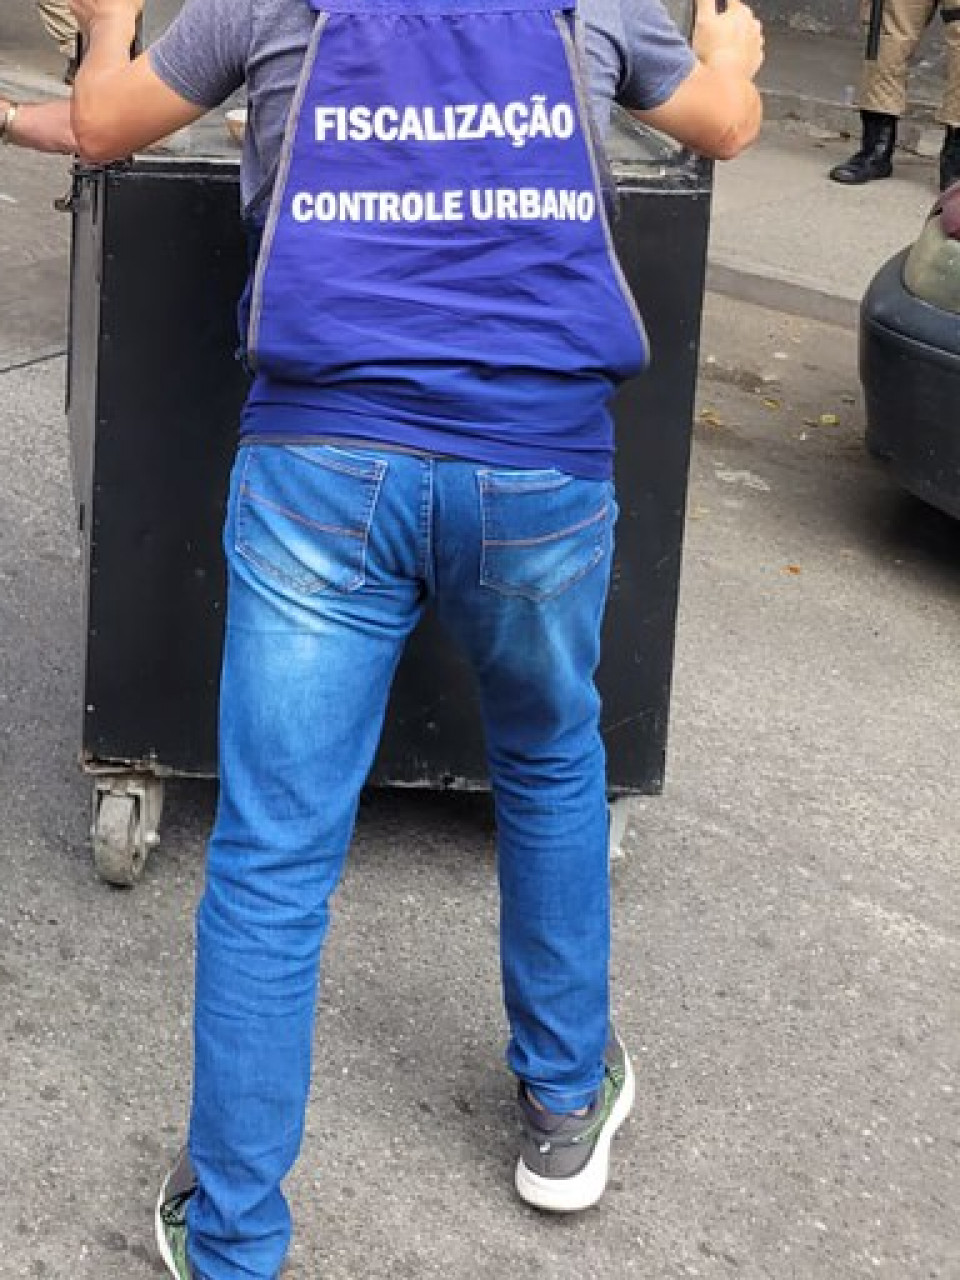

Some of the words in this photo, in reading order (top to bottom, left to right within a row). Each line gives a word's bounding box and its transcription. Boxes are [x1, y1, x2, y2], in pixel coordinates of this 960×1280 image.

[314, 94, 575, 148] FISCALIZAÇÃO
[292, 190, 464, 223] CONTROLE
[470, 187, 596, 223] URBANO
